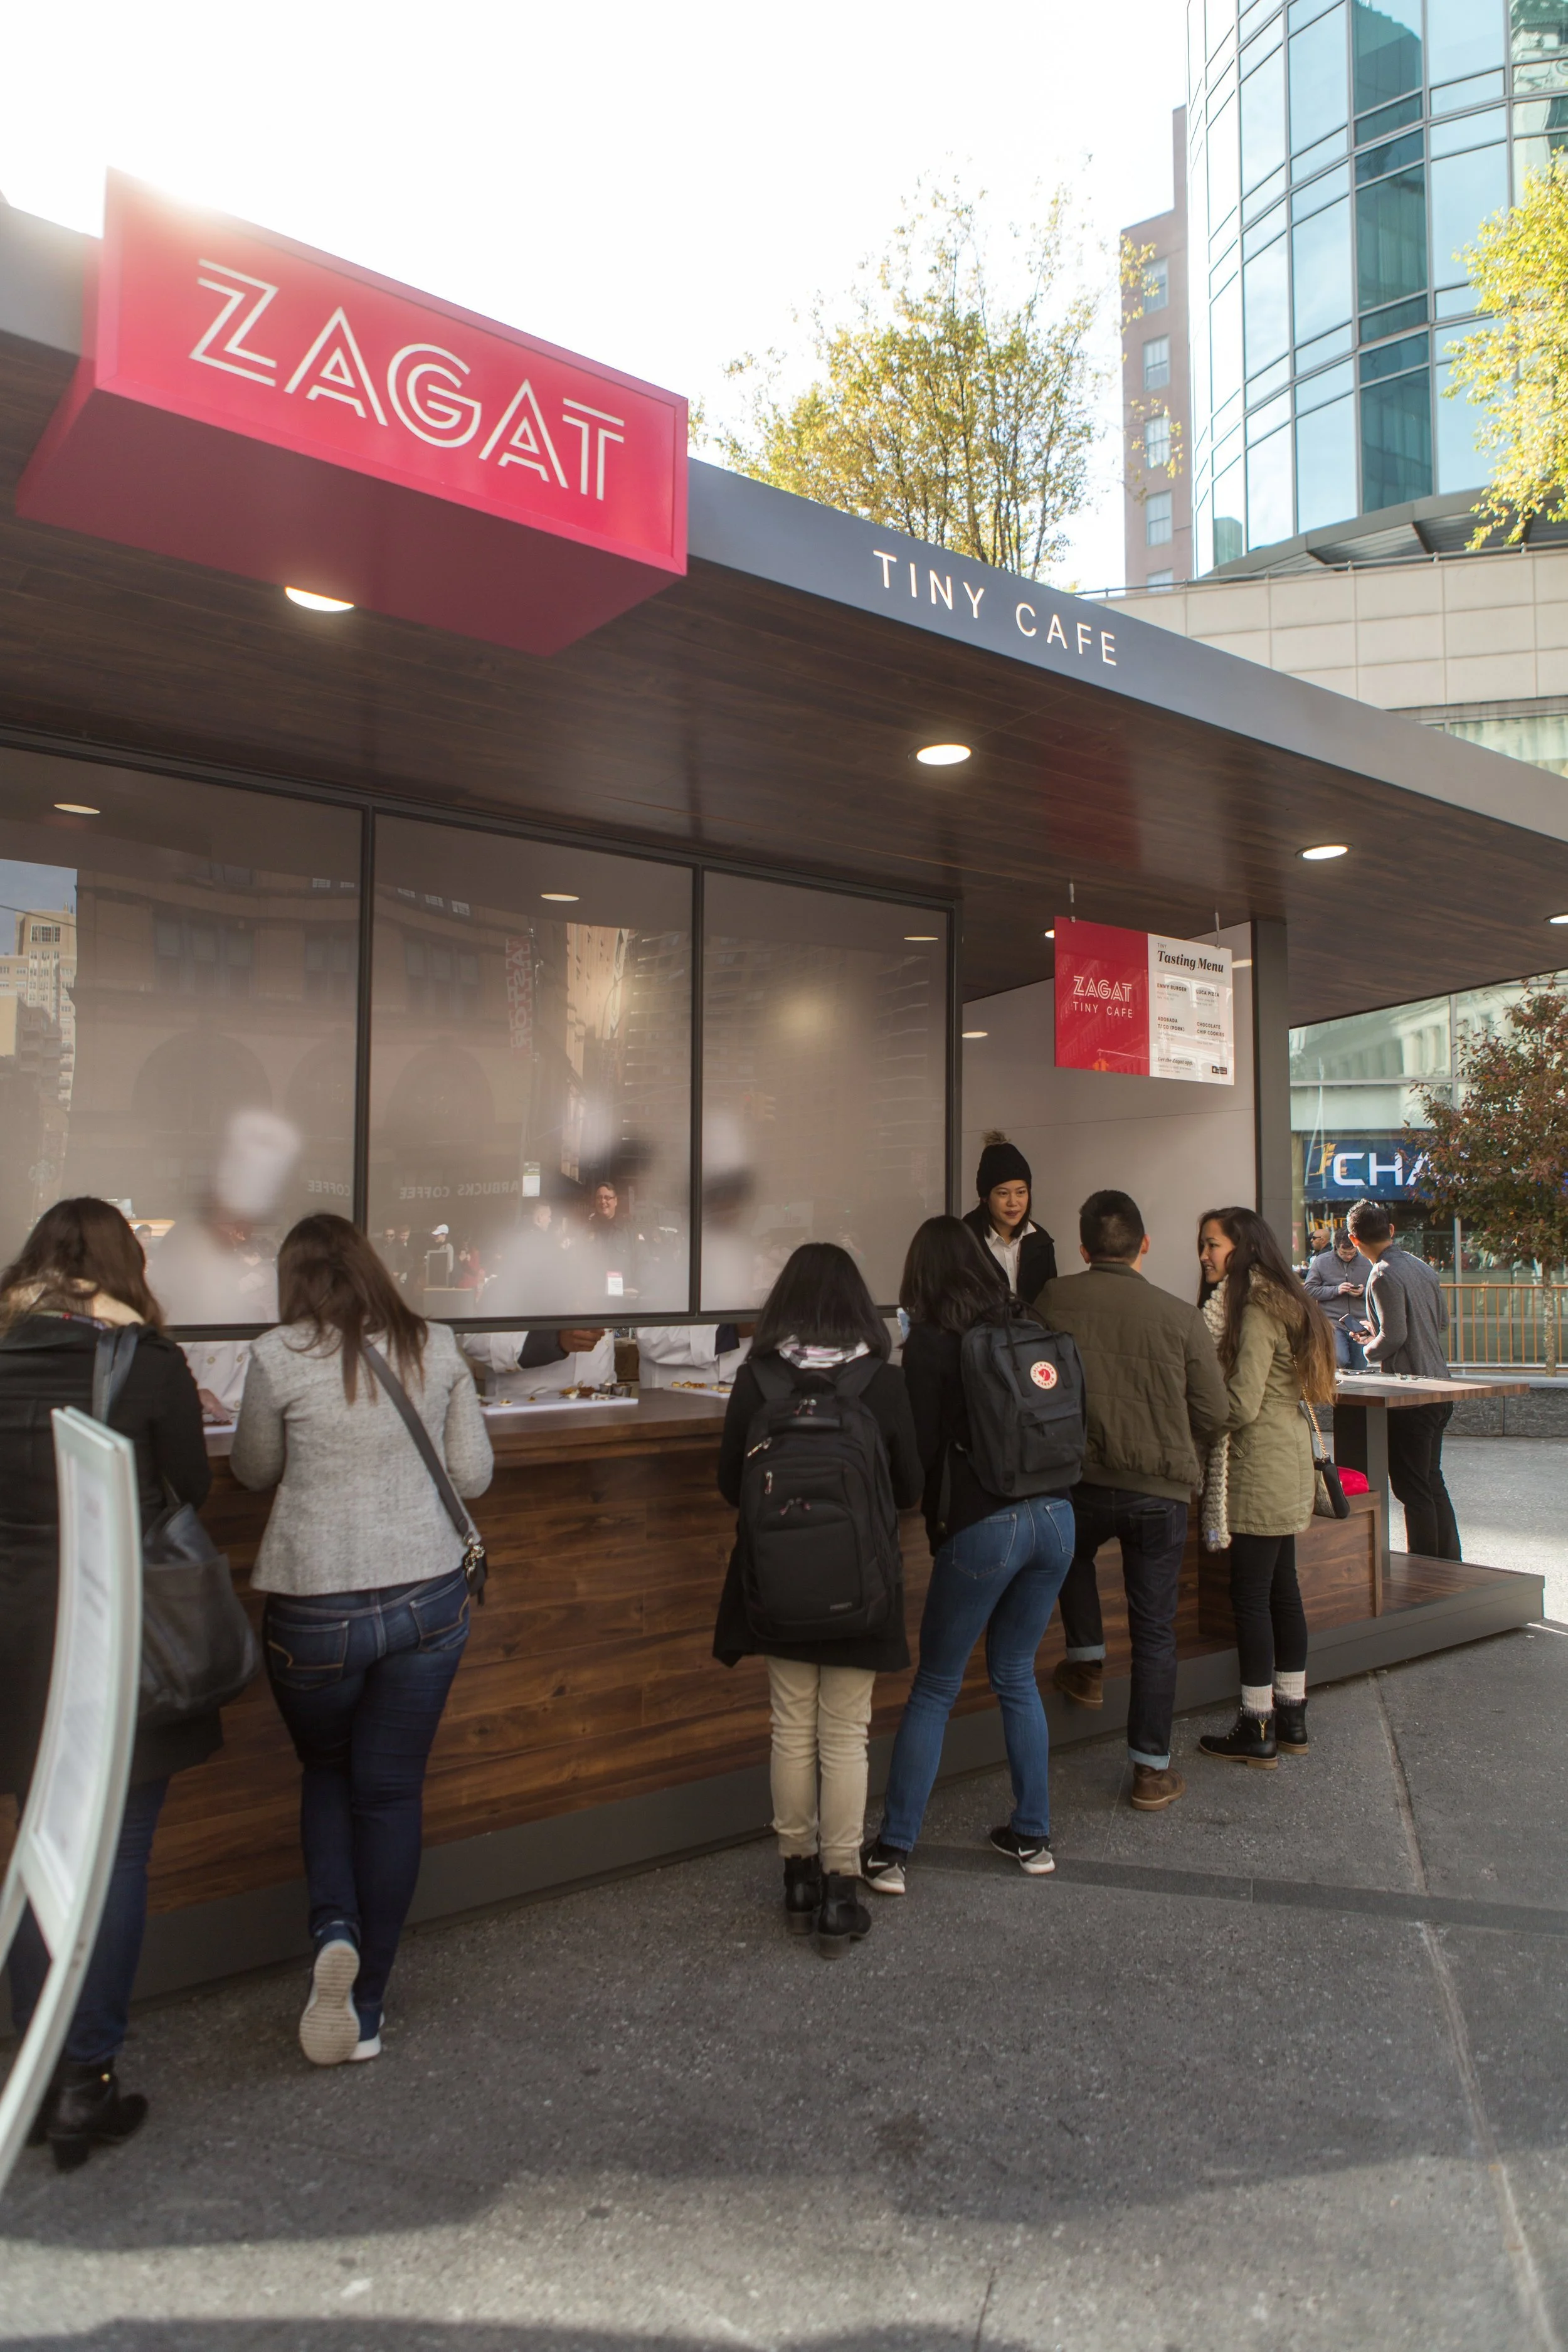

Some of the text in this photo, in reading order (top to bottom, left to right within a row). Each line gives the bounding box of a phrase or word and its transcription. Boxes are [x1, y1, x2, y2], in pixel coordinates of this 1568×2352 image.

[188, 258, 625, 501] ZAGAT
[872, 549, 1117, 666] TINY CAFE
[1157, 950, 1224, 973] Tasting Menu
[1073, 975, 1132, 1002] ZAGAT
[1073, 1001, 1133, 1019] TINY CAFE
